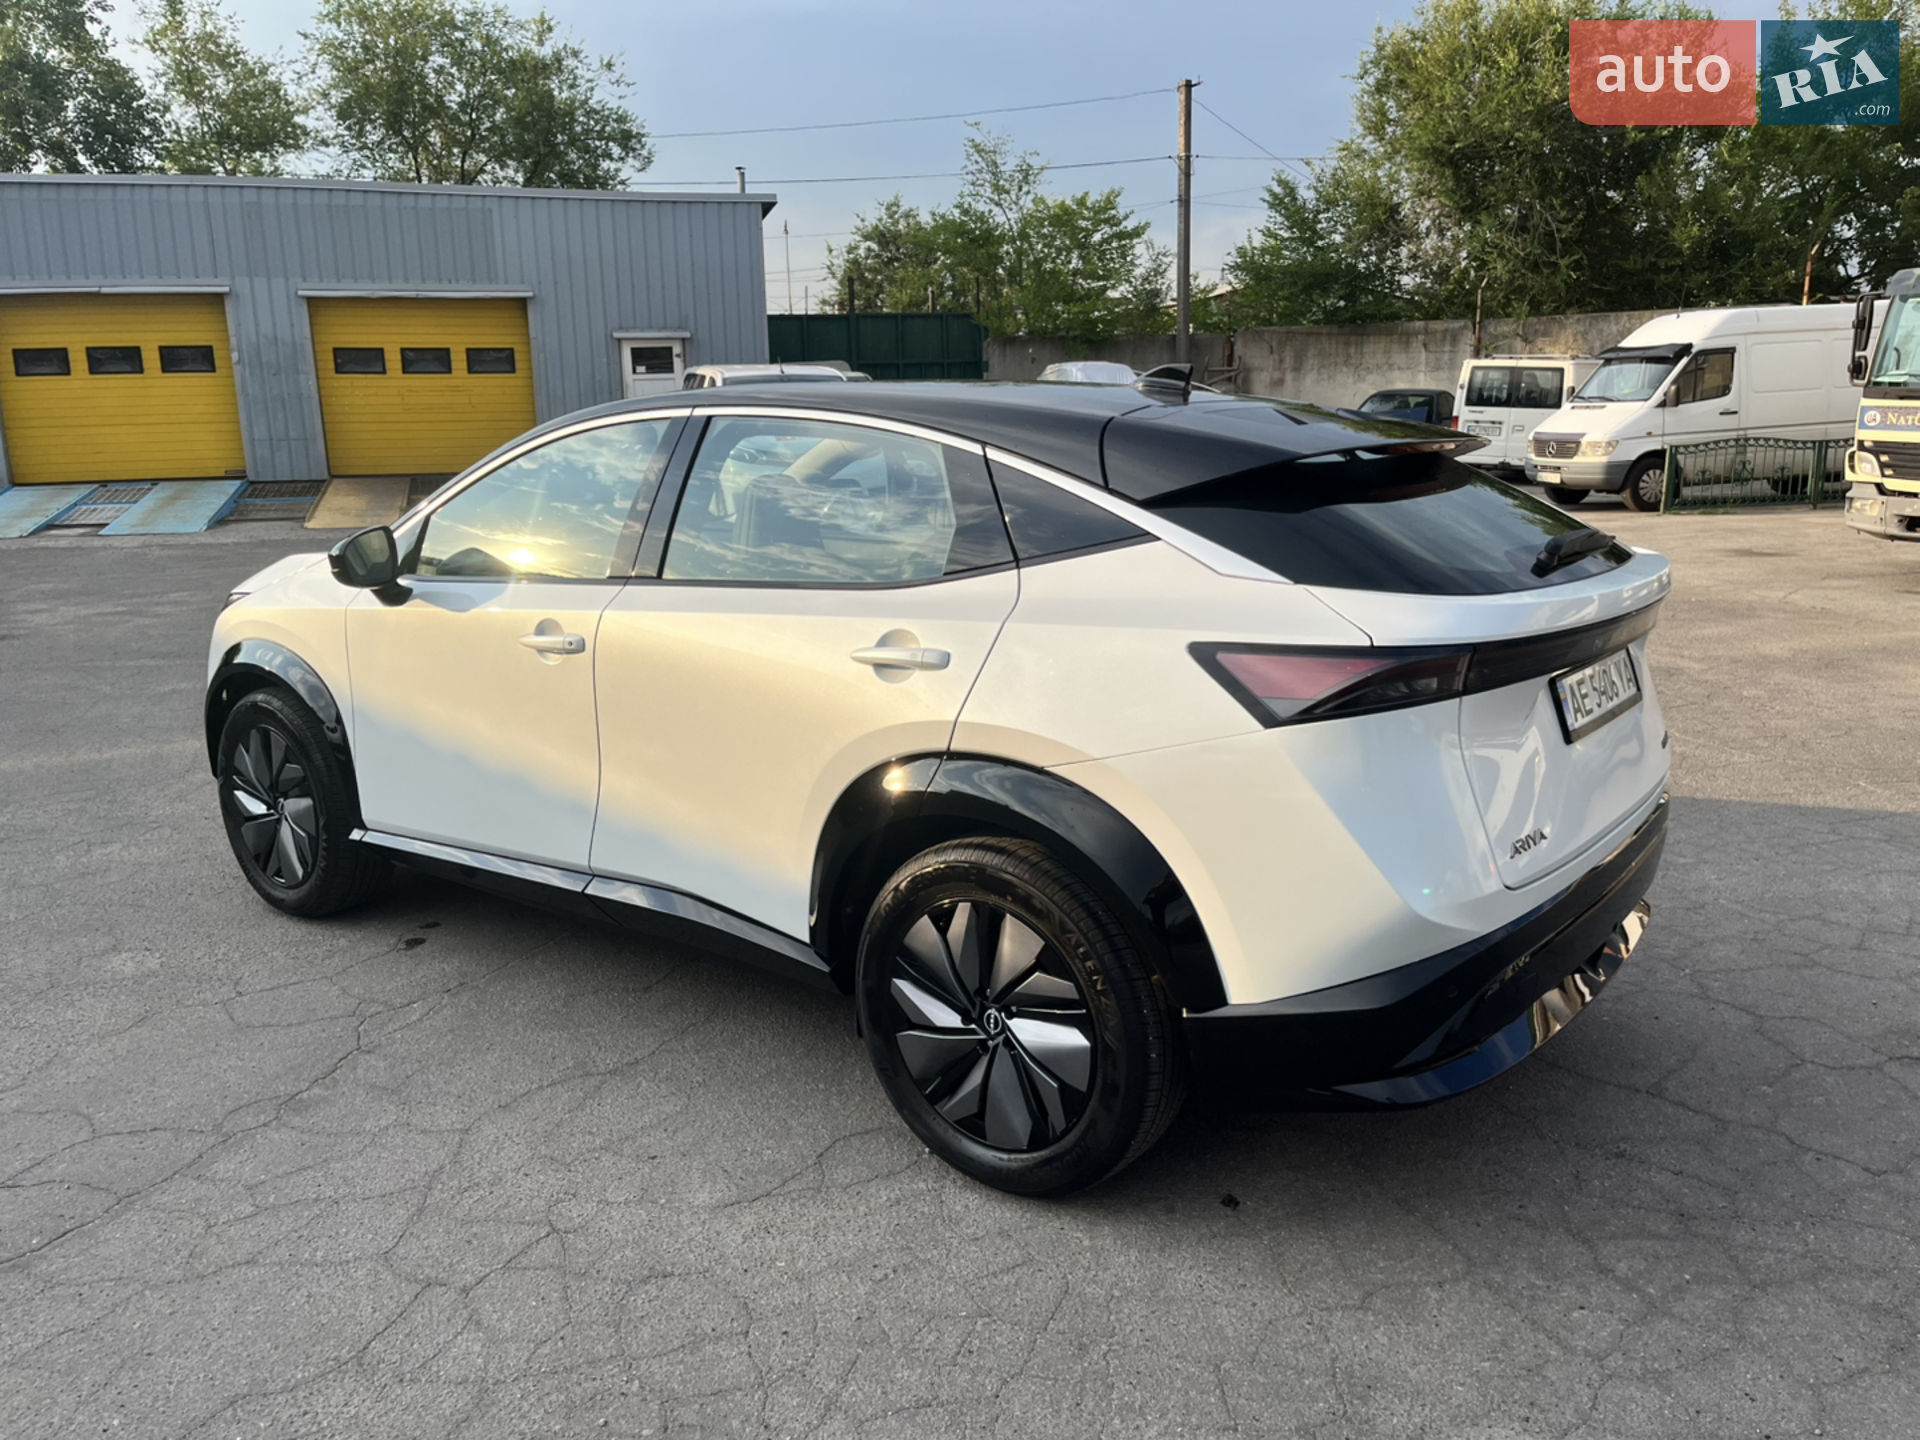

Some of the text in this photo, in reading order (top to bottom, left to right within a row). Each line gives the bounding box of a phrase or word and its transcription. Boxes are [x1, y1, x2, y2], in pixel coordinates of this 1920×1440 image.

[1568, 678, 1595, 723] AE
[1613, 656, 1637, 694] YA
[1509, 828, 1548, 860] ARIYA
[1063, 932, 1120, 1027] ALENZA
